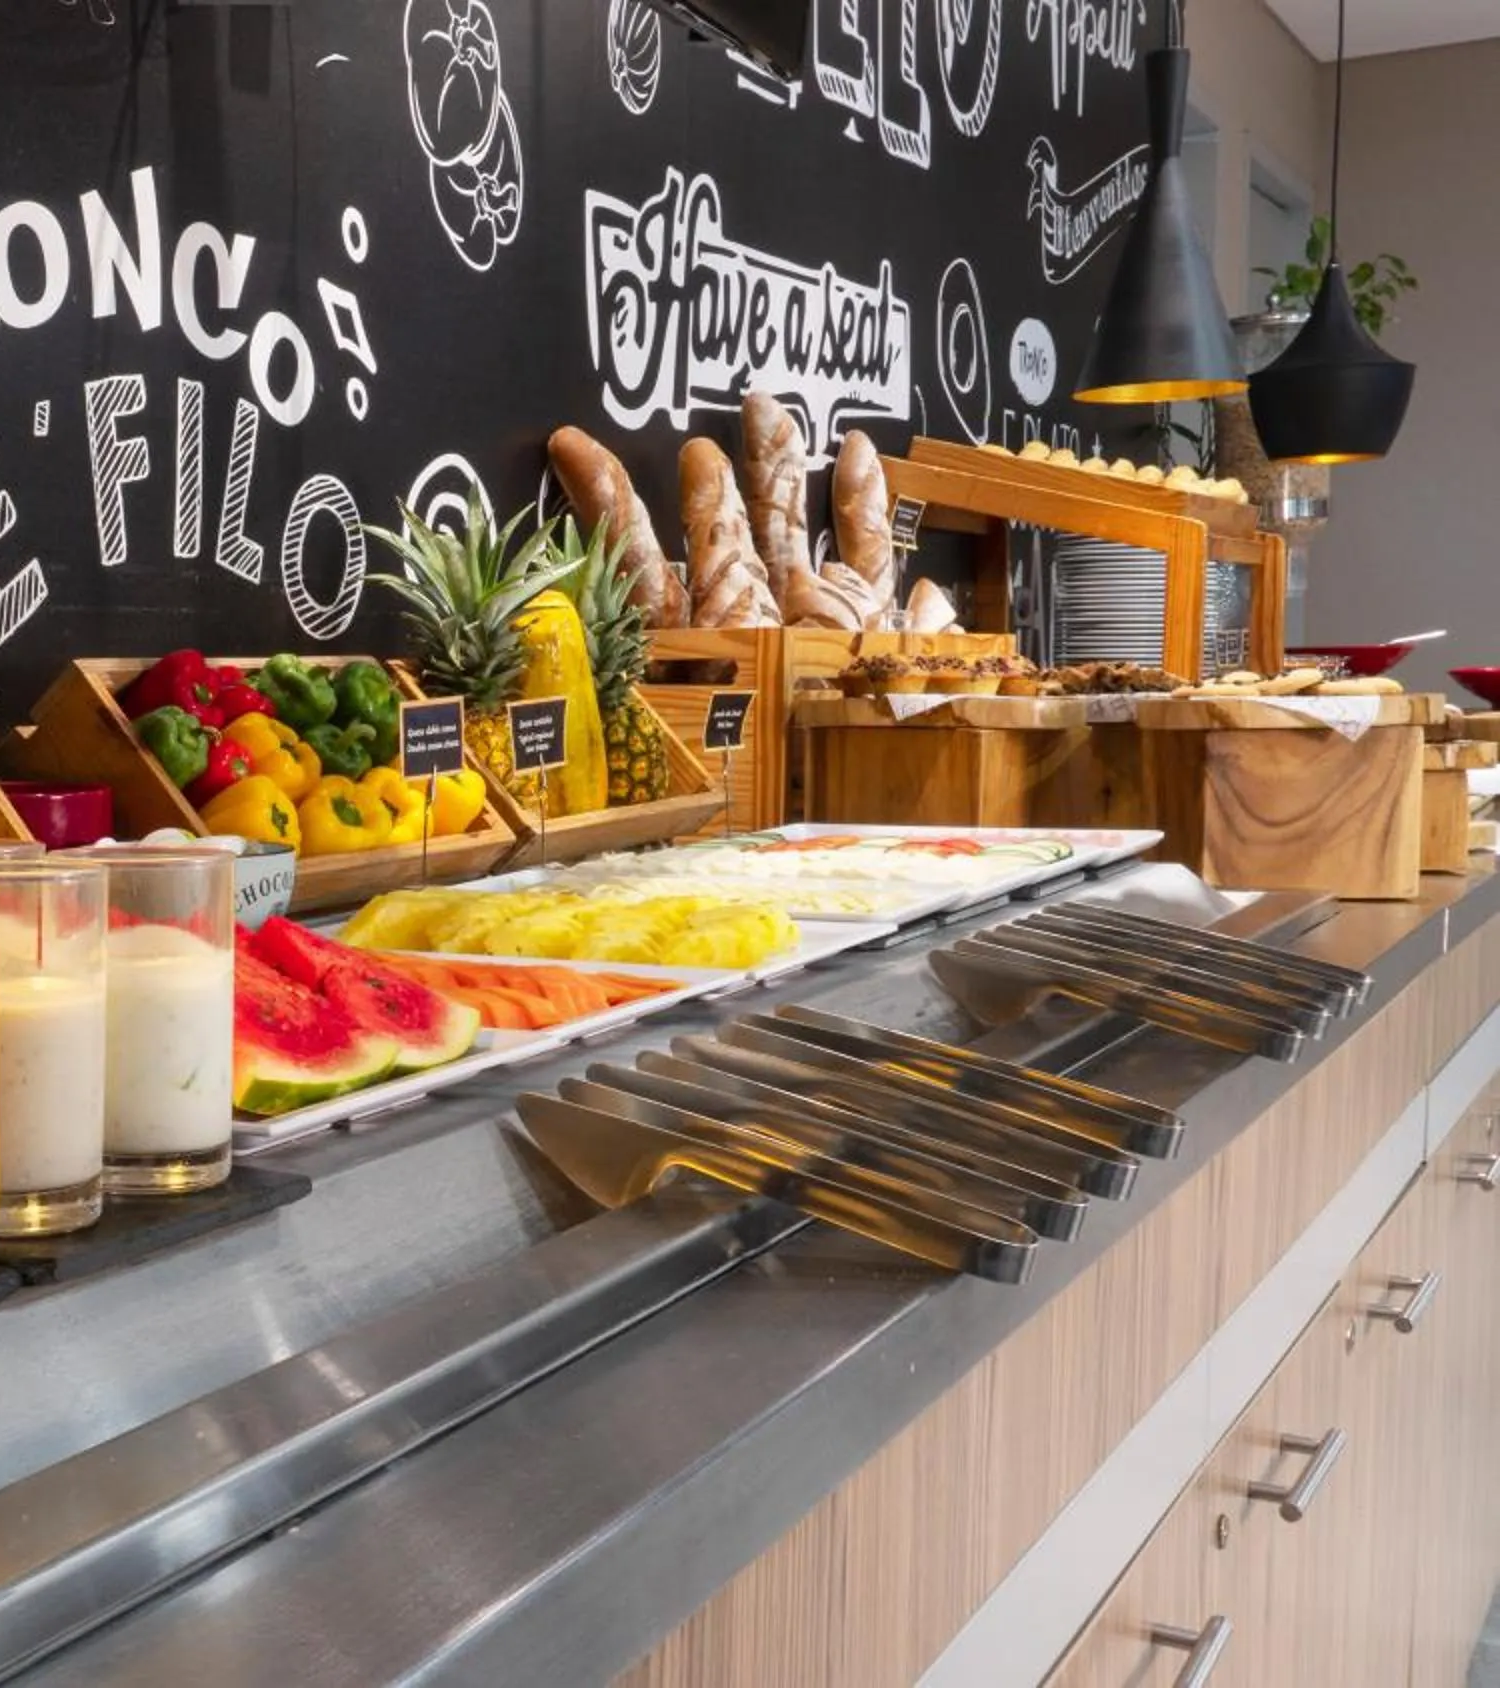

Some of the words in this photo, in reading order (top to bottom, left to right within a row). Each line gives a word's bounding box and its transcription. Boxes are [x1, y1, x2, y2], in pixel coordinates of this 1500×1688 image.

[784, 281, 814, 376] a
[815, 258, 899, 386] seat
[85, 373, 367, 641] FILO
